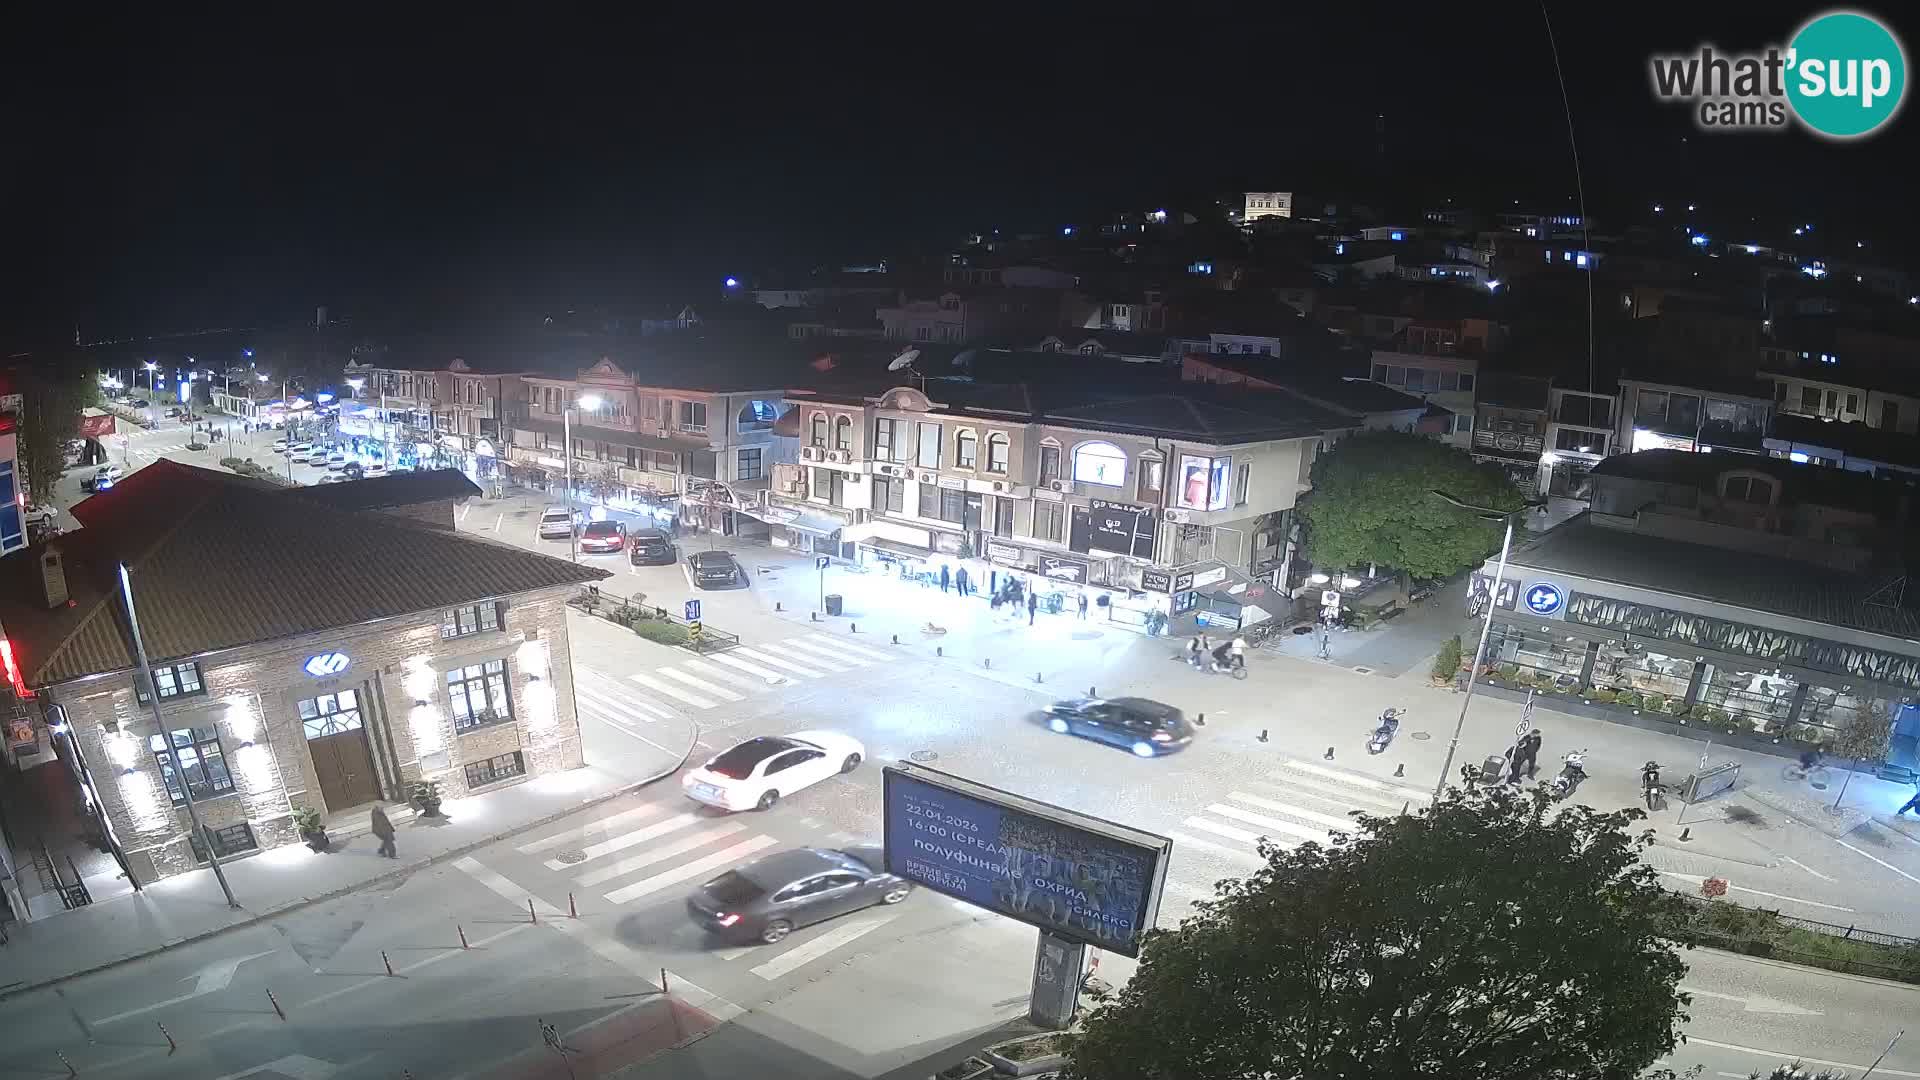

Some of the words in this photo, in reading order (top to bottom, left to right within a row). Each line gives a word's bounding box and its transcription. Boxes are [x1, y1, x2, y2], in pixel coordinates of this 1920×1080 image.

[907, 818, 947, 837] 16:00
[1035, 878, 1087, 902] ОХРИД
[1073, 906, 1129, 928] СИЛЕКС
